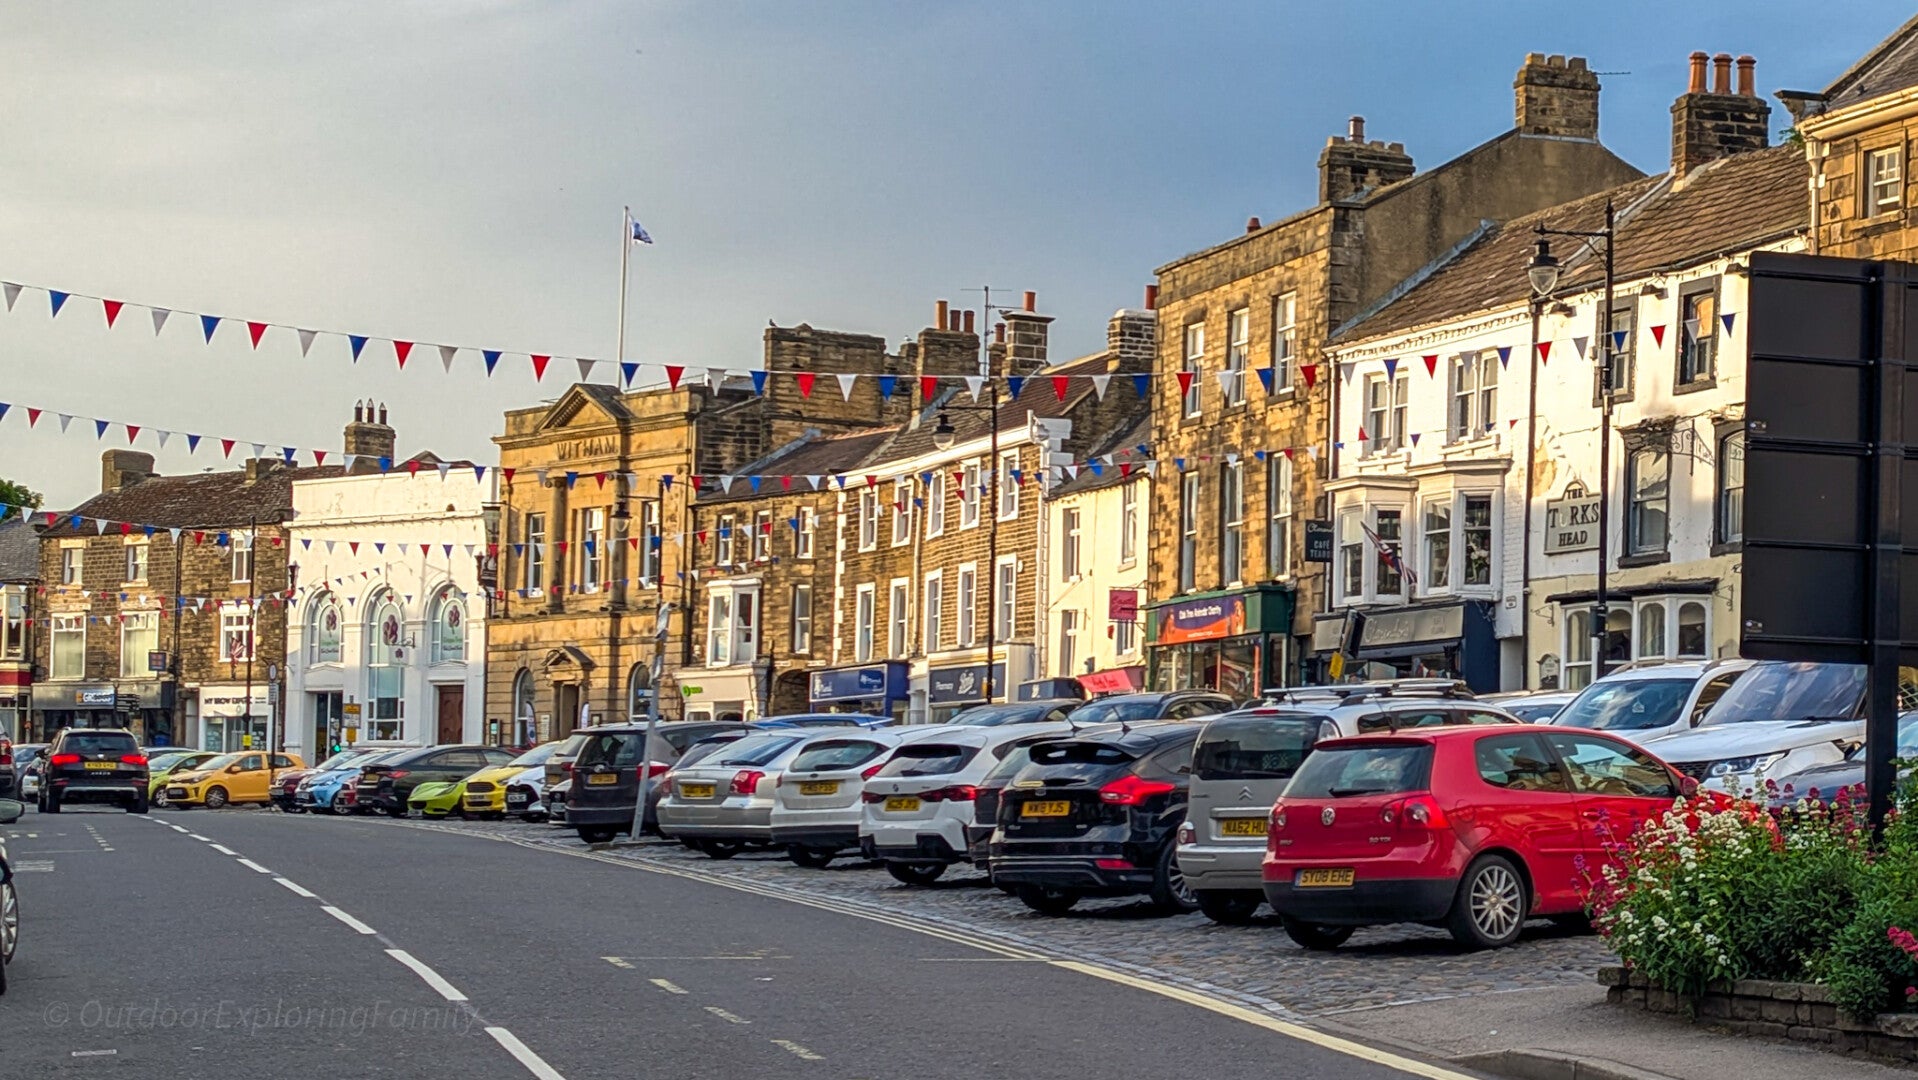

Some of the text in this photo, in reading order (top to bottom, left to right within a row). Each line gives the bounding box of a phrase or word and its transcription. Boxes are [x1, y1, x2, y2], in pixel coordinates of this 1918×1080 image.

[556, 435, 616, 460] WITHAM
[1566, 488, 1583, 499] THE
[1558, 530, 1588, 547] HEAD
